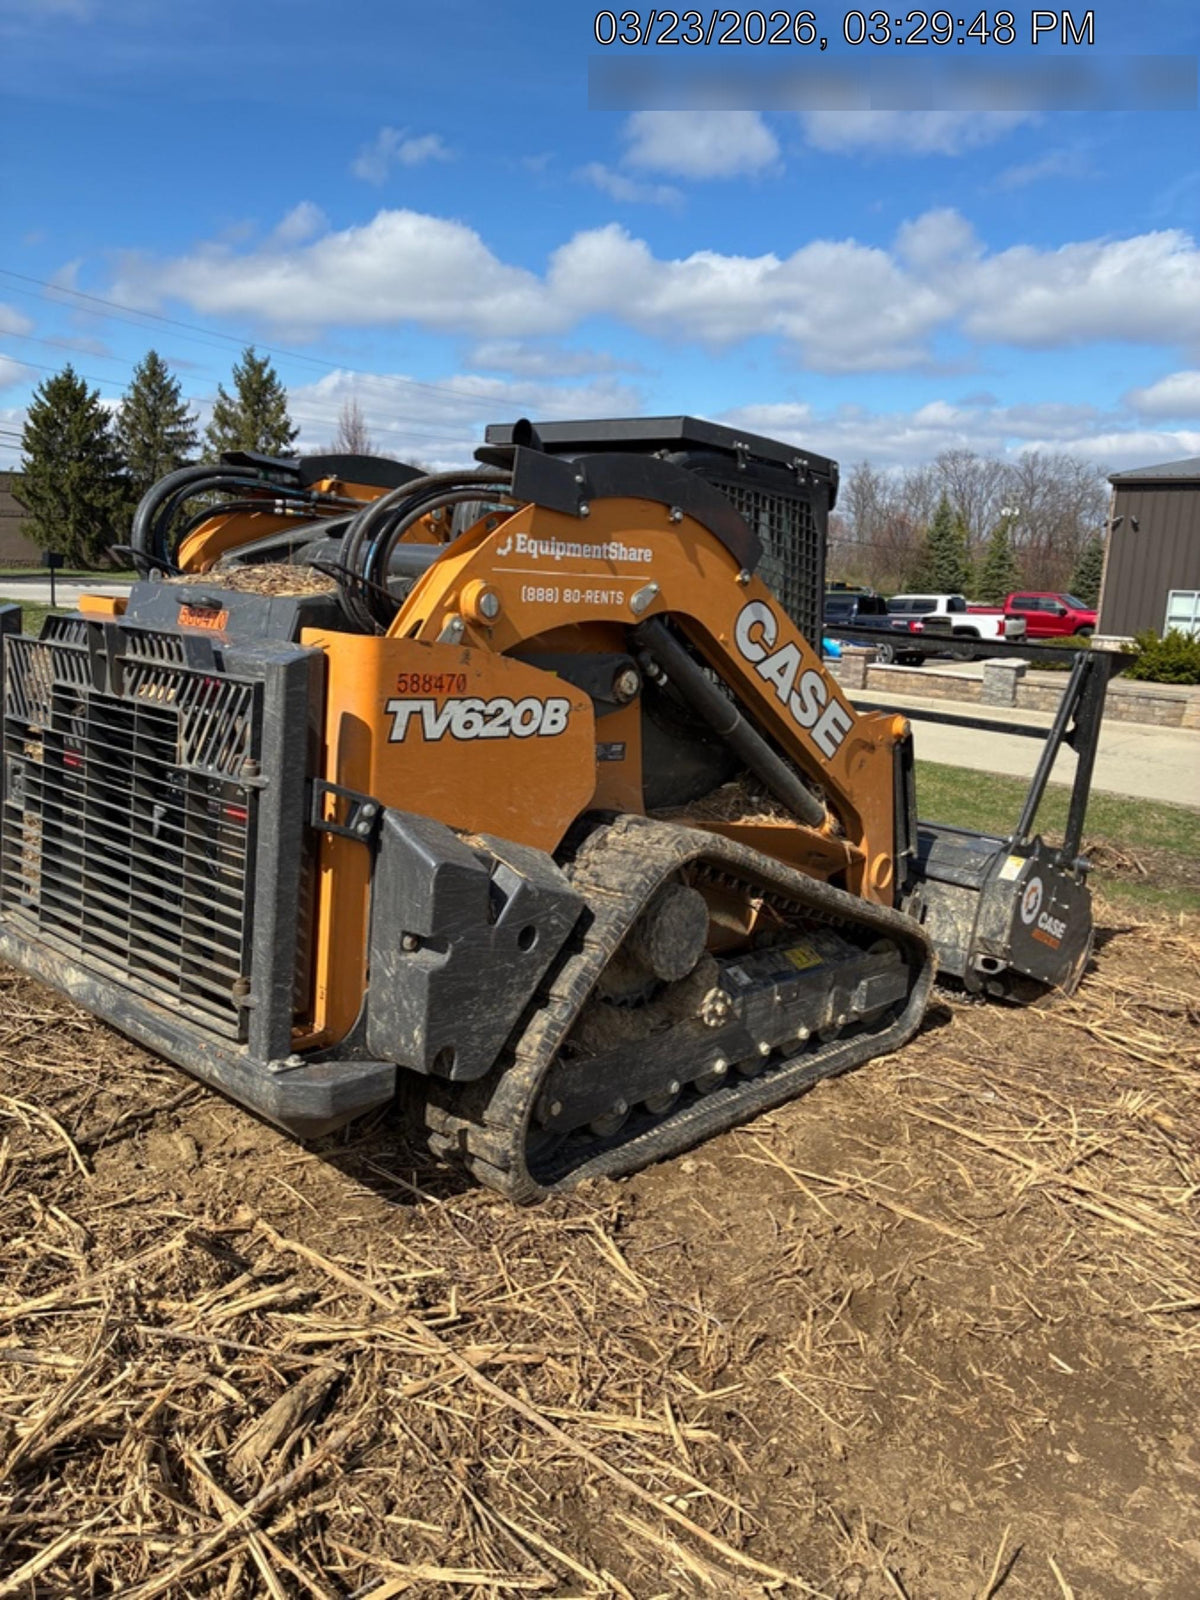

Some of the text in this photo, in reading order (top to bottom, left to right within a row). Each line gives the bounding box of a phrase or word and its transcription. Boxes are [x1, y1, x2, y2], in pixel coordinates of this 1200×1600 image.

[515, 533, 653, 562] EquipmentShare
[521, 585, 624, 605] (888) 80-RENTS
[397, 673, 467, 694] 588470
[734, 599, 855, 761] CASE
[385, 696, 571, 743] TV620B
[1037, 911, 1067, 939] CASE
